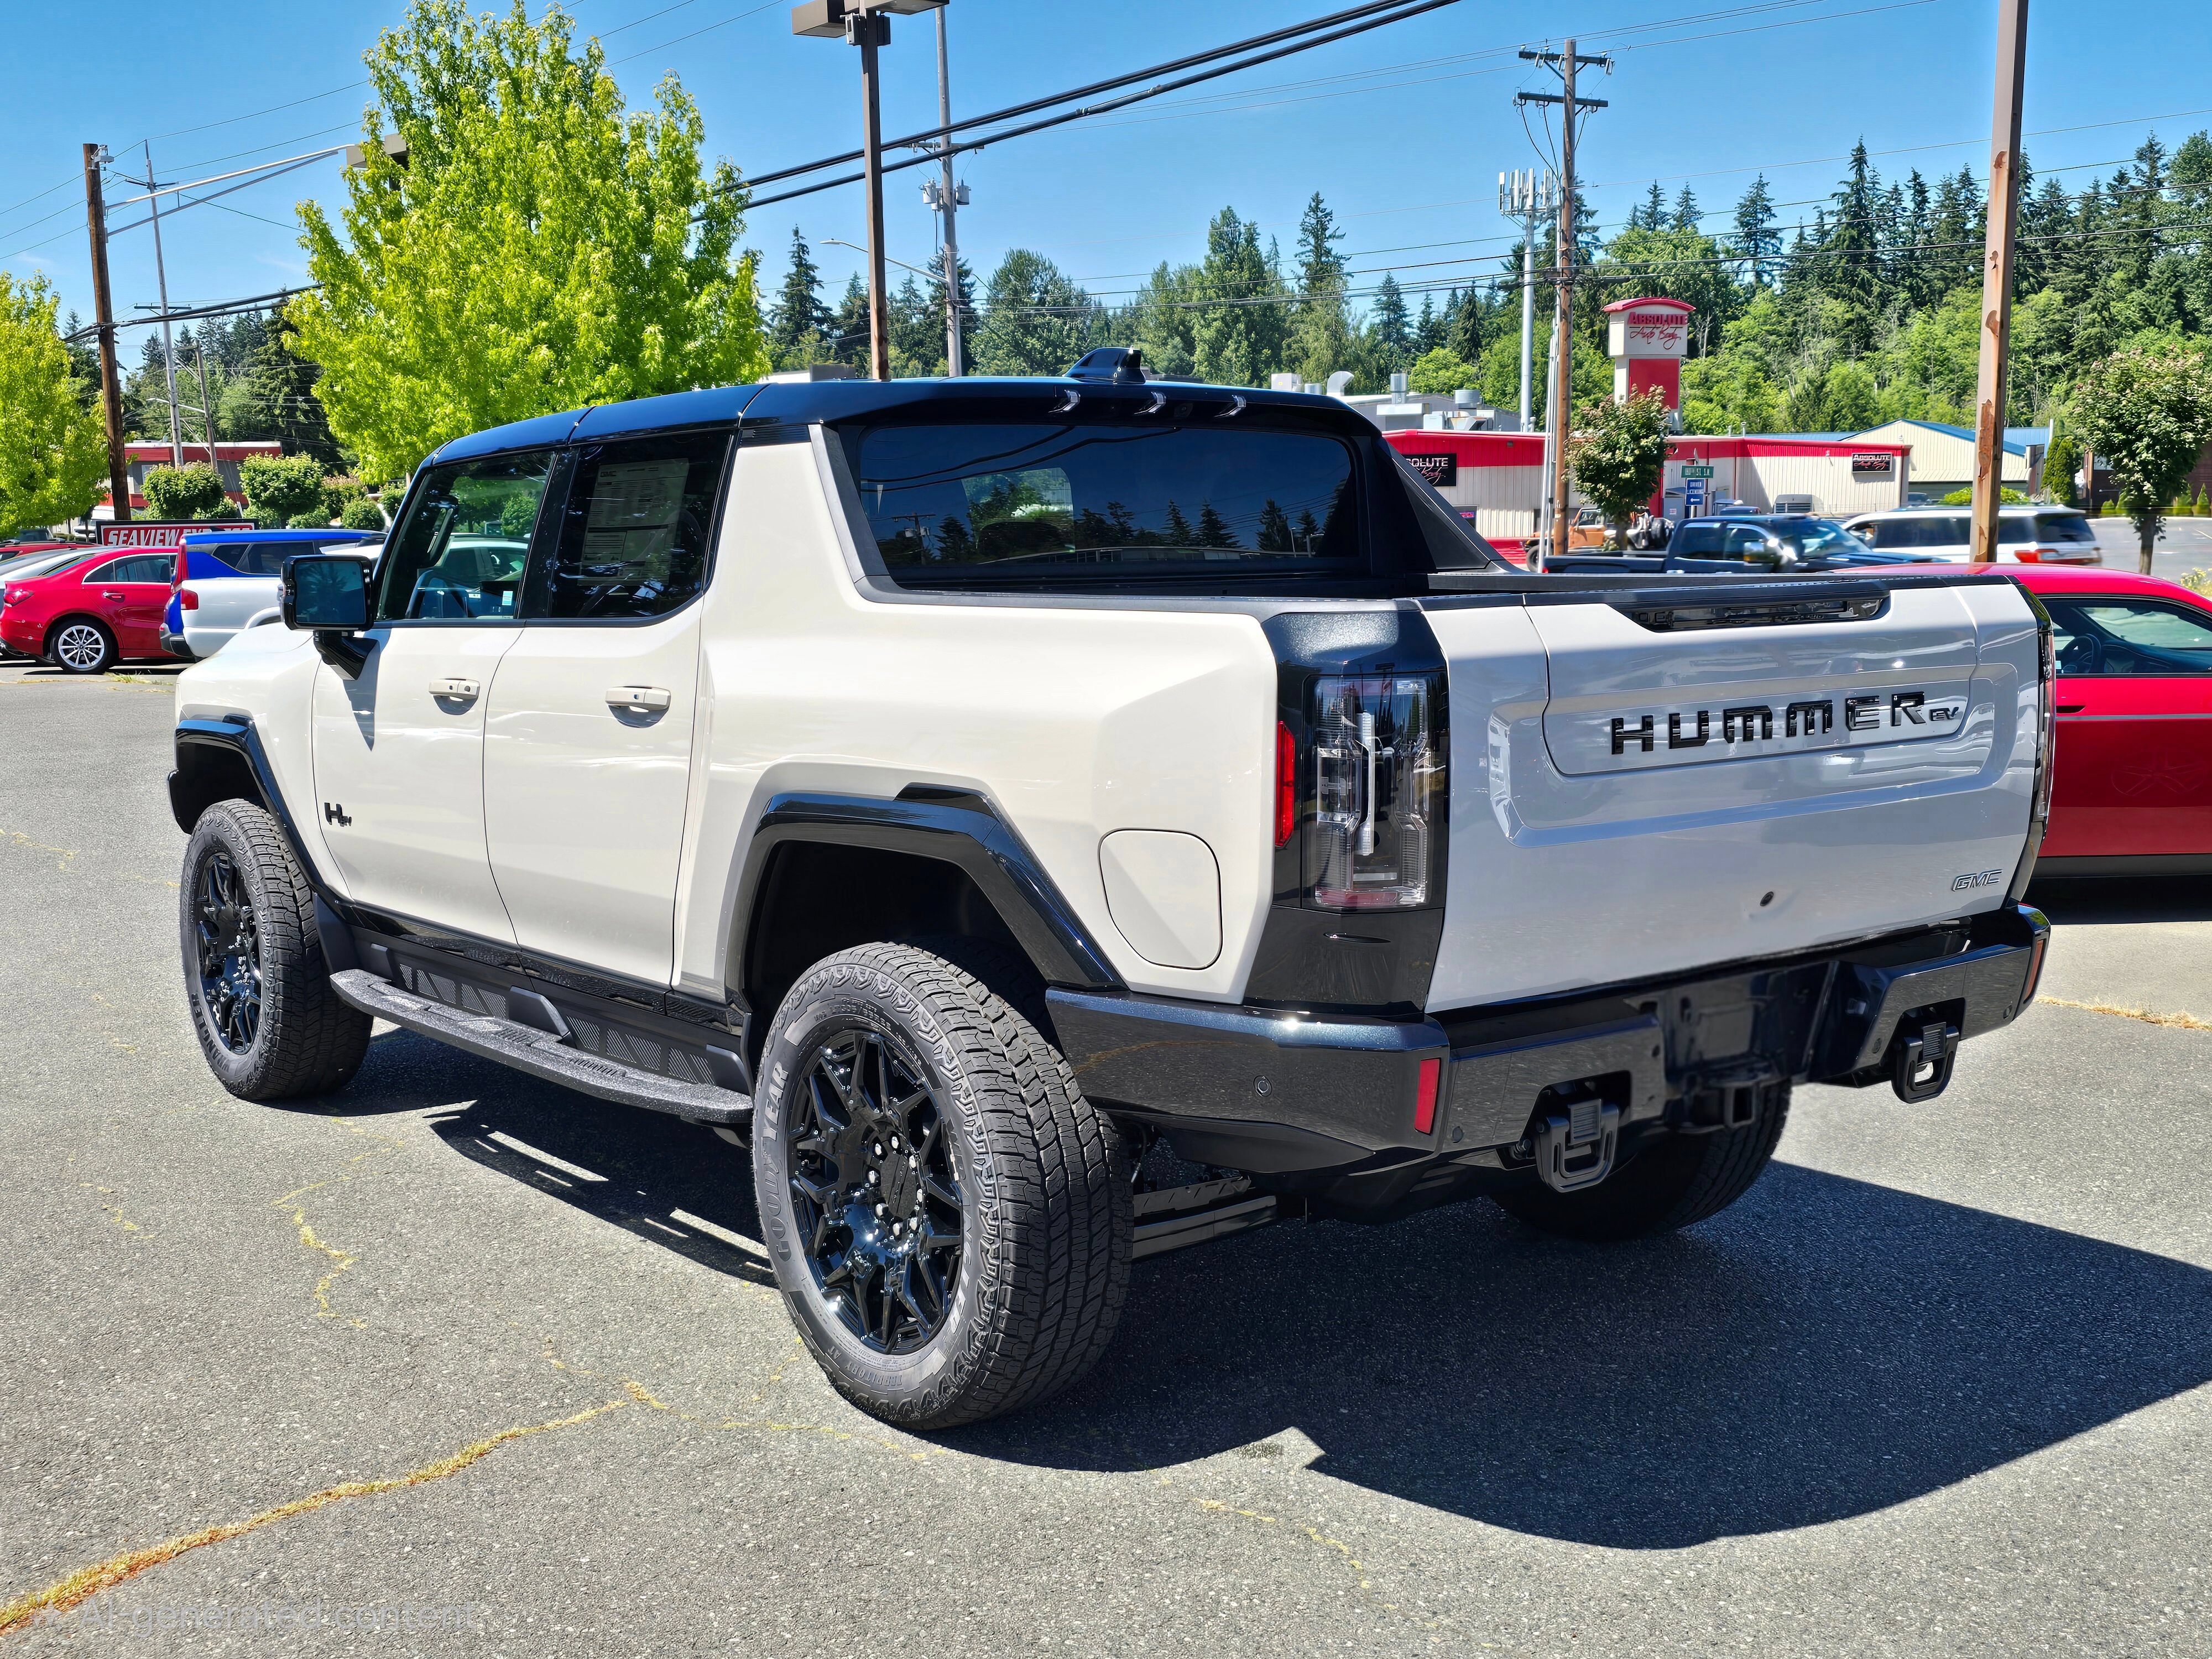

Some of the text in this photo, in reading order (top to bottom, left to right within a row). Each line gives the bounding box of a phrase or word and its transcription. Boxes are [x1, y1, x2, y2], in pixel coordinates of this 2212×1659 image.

[1405, 458, 1448, 467] OLUTE
[108, 529, 181, 546] SEAVIEW
[1611, 691, 1959, 755] HUMMER EV
[1952, 869, 2003, 891] GMC
[761, 1061, 792, 1262] GOODYEAR
